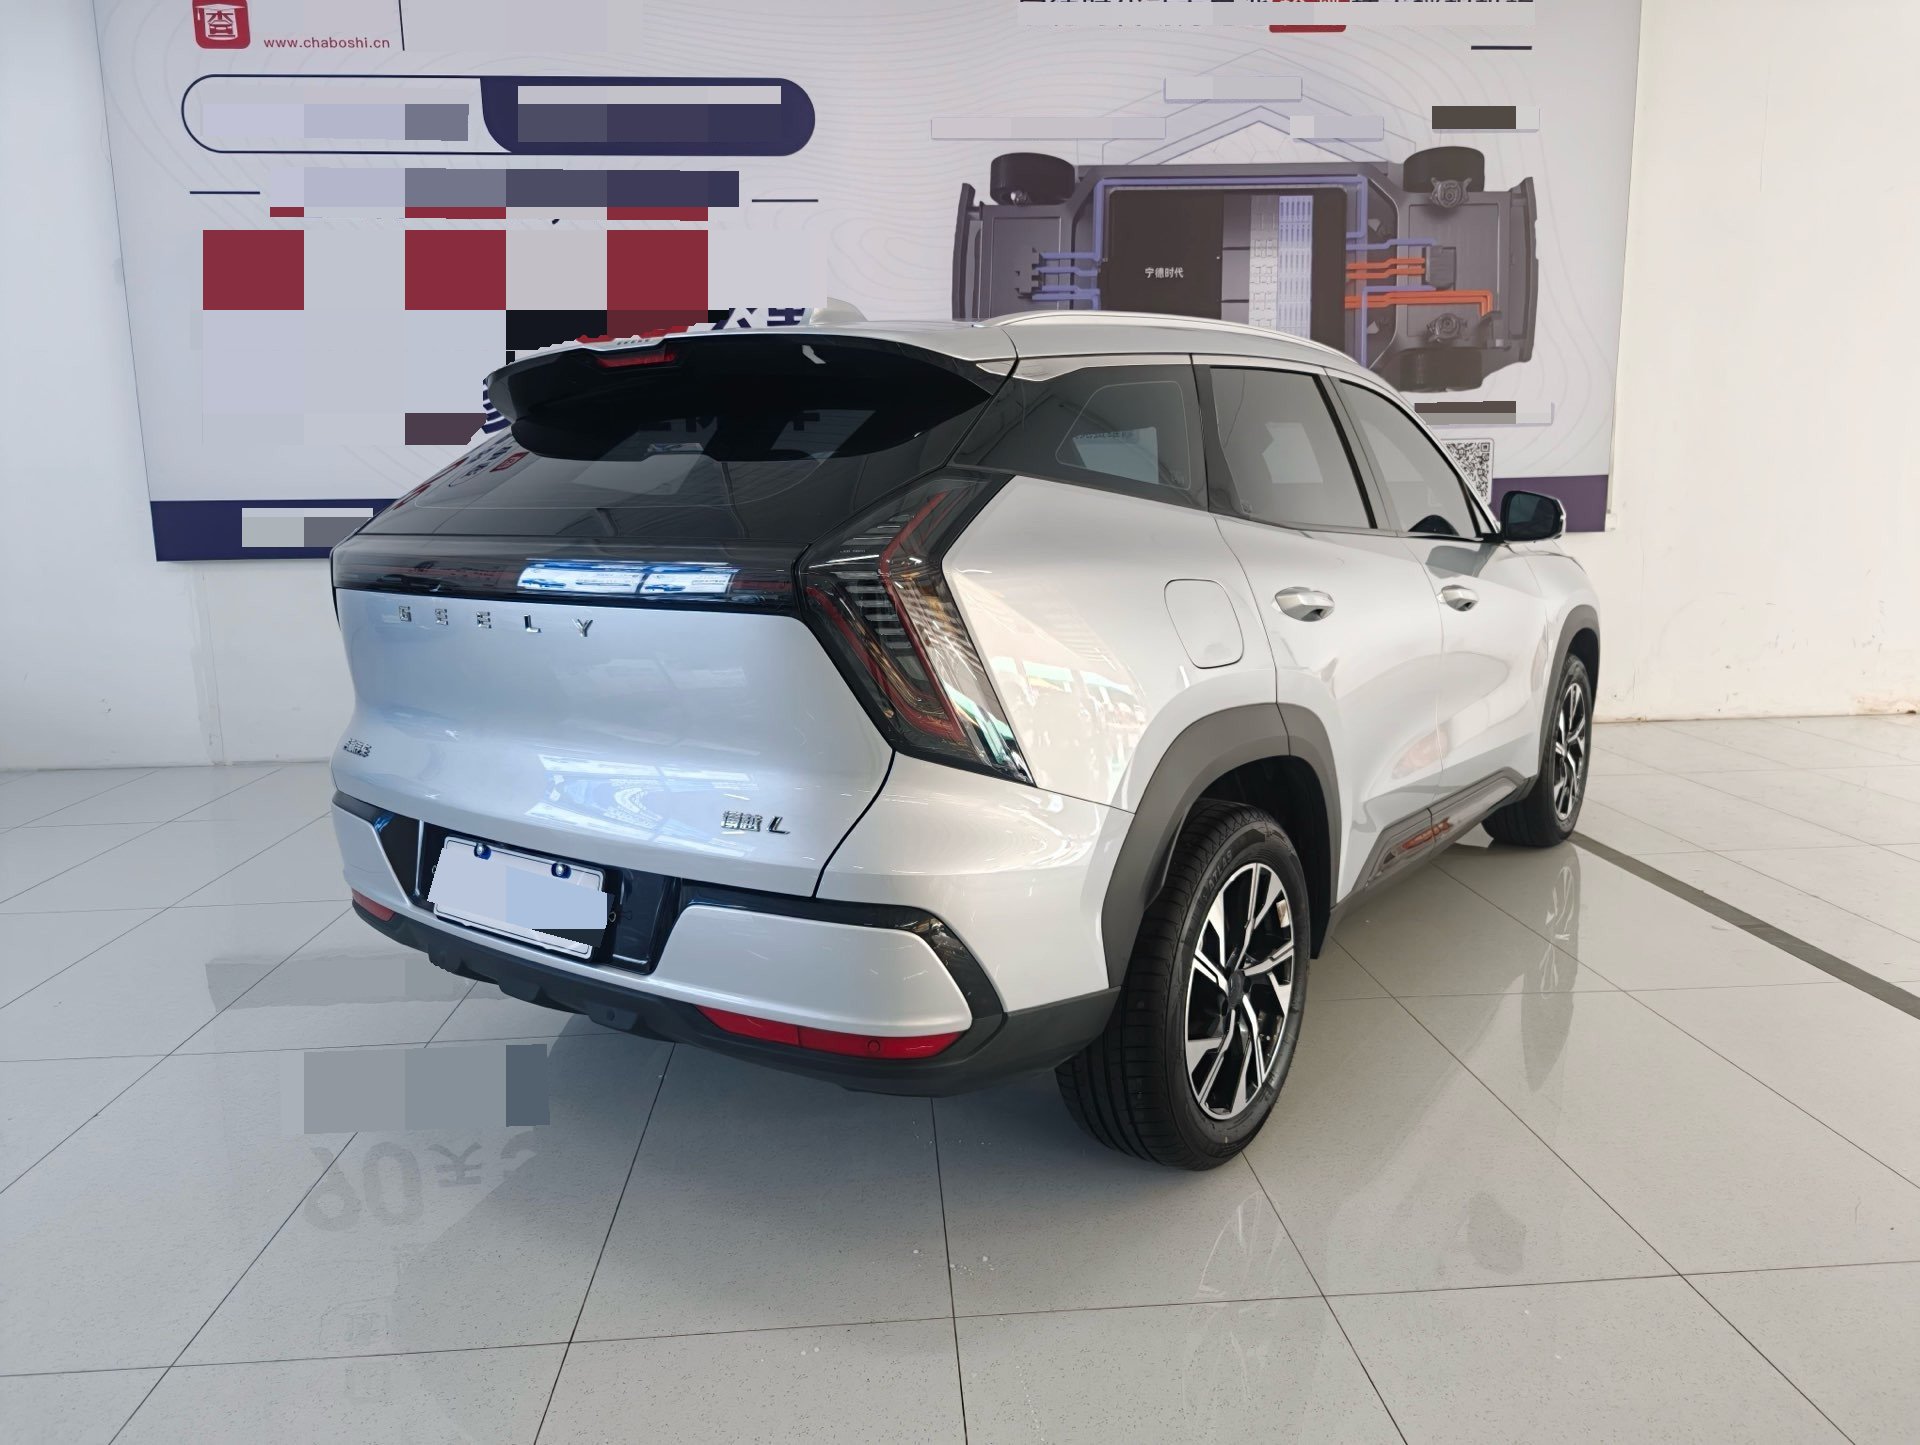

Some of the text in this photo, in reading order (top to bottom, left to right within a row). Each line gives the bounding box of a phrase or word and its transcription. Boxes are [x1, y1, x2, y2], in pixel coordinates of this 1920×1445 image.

[263, 37, 391, 49] www.chaboshi.cn
[1144, 266, 1184, 279] 宁德时代
[399, 605, 594, 637] GEELY
[766, 815, 791, 835] L
